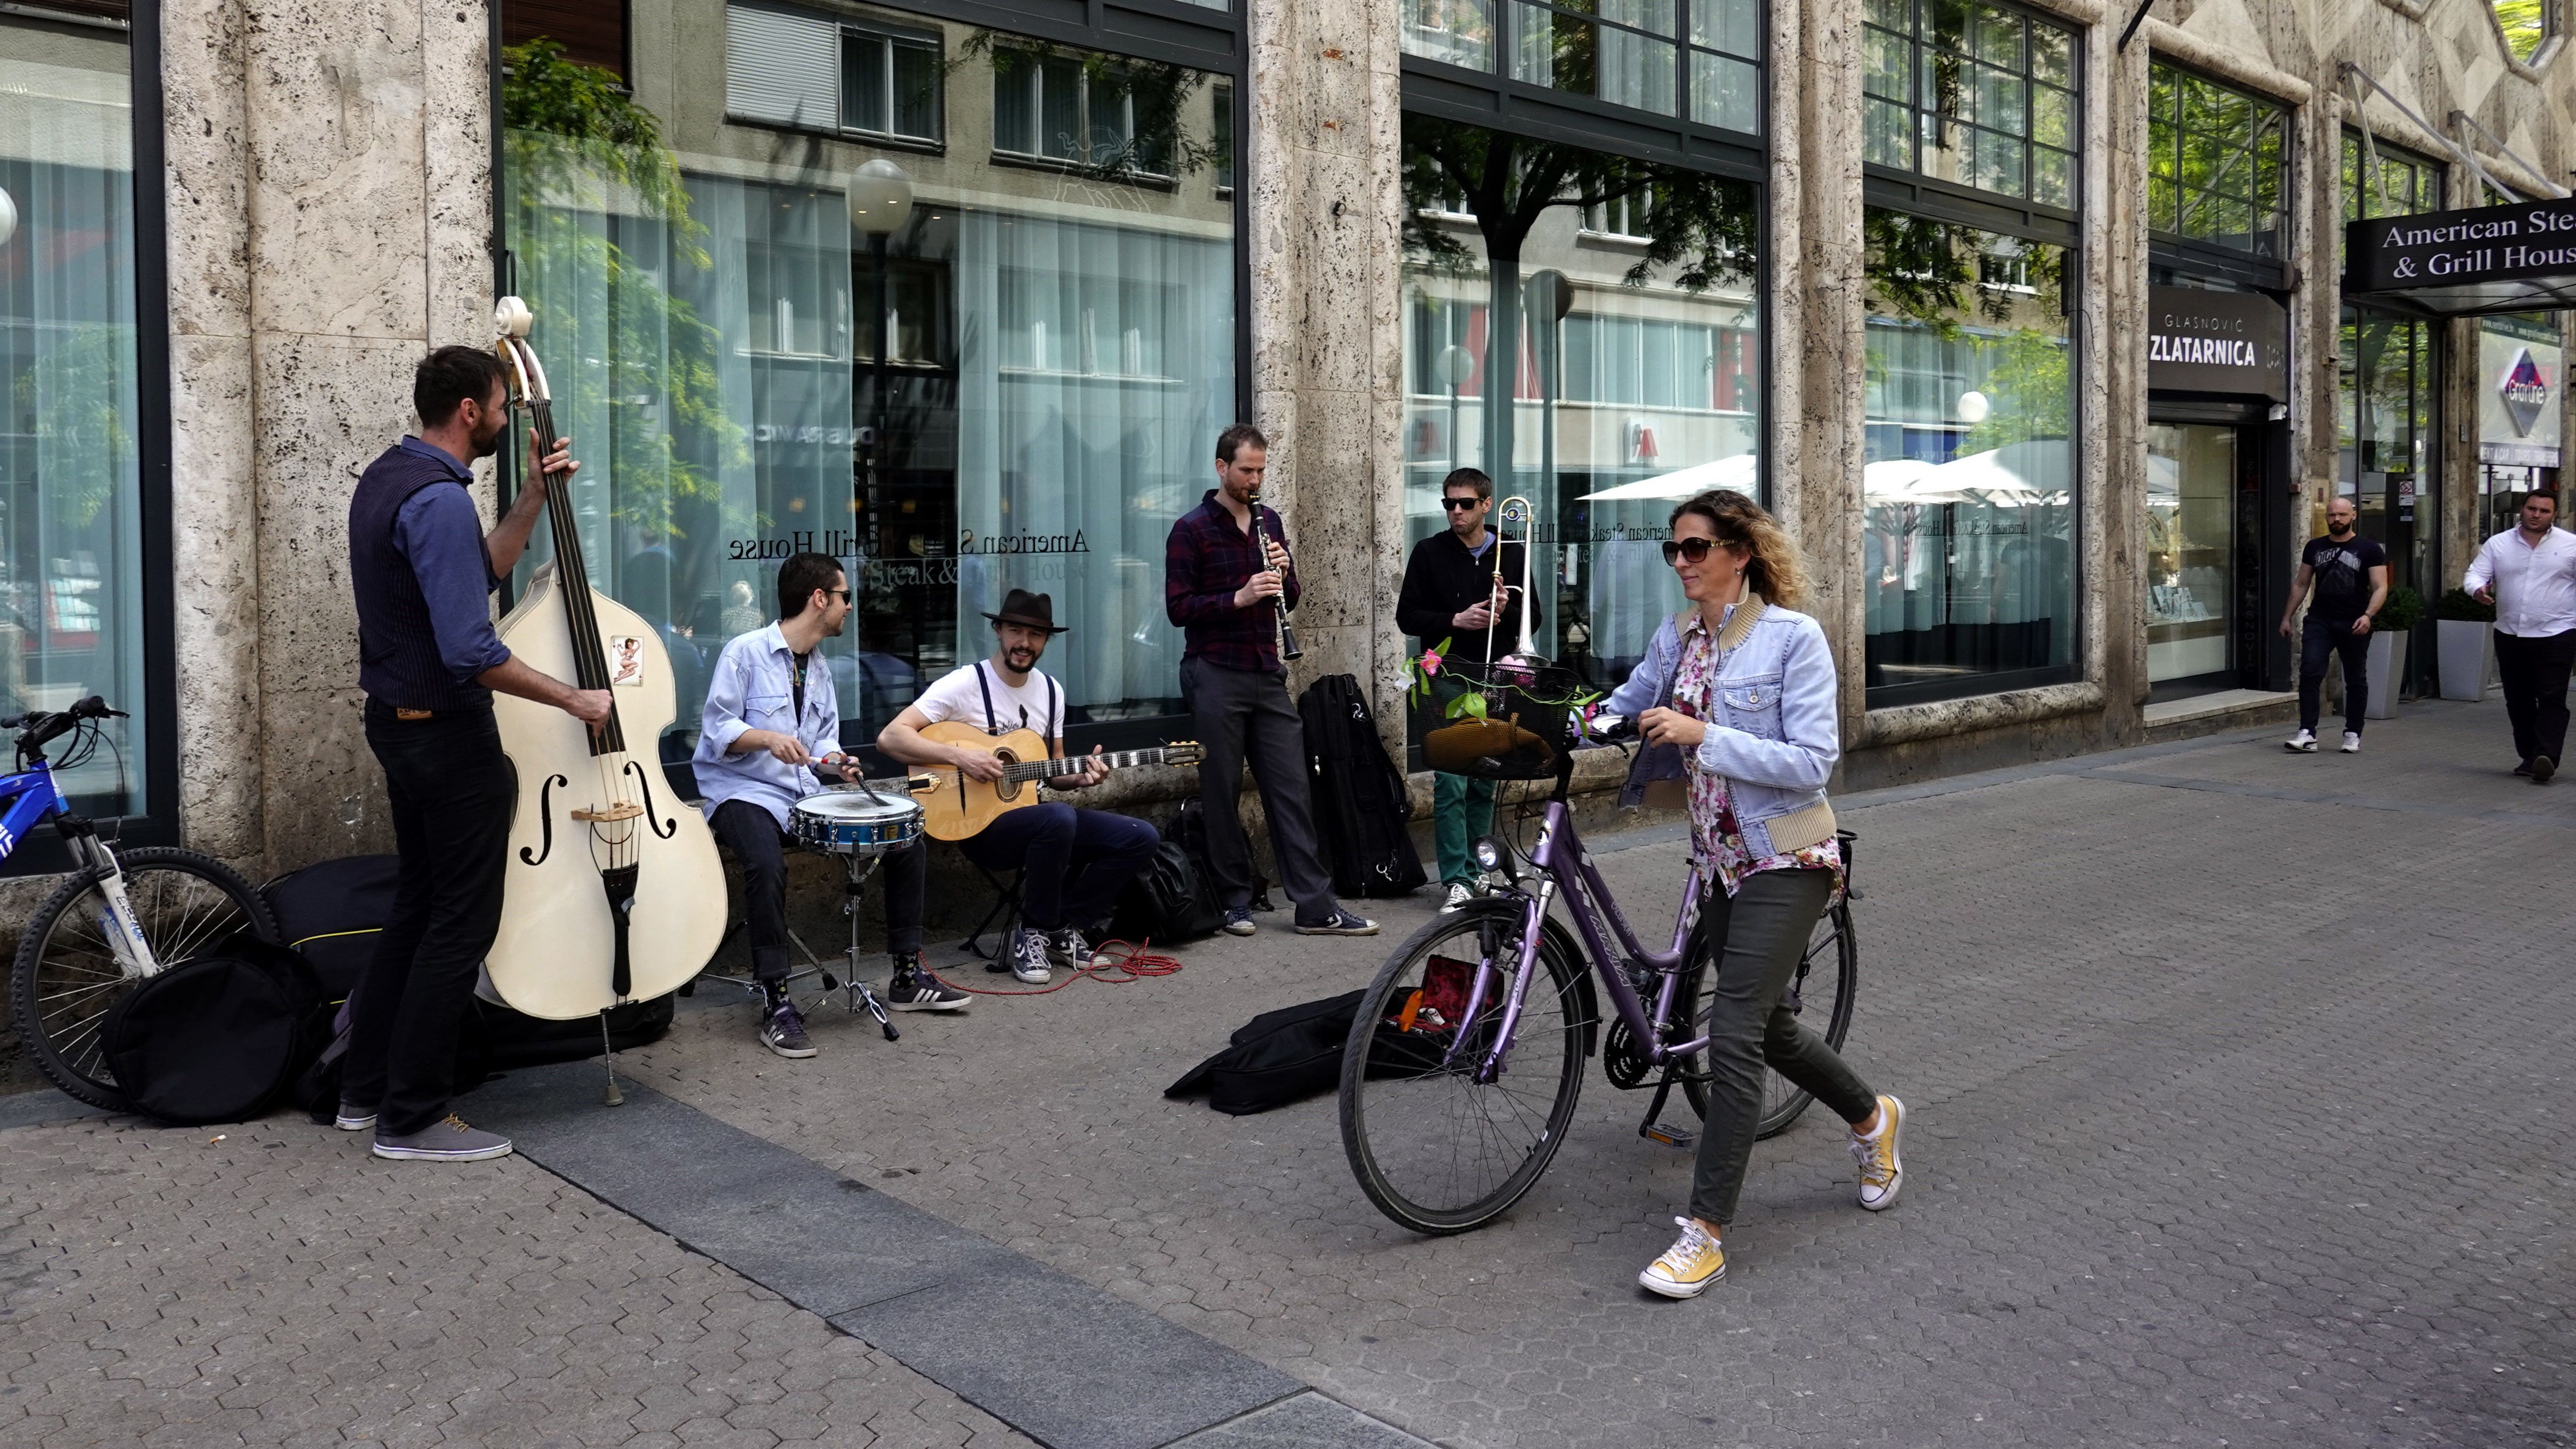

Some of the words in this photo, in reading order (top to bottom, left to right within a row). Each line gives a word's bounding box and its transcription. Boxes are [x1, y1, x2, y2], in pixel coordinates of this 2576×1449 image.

[2382, 218, 2518, 249] American
[2528, 211, 2576, 233] Ste
[2393, 257, 2418, 278] &
[2428, 249, 2492, 275] Grill
[2164, 314, 2243, 332] GLASNOVIĆ
[2150, 334, 2256, 367] ZLATARNICA
[938, 558, 958, 585] &
[1589, 915, 1631, 987] MAXIM
